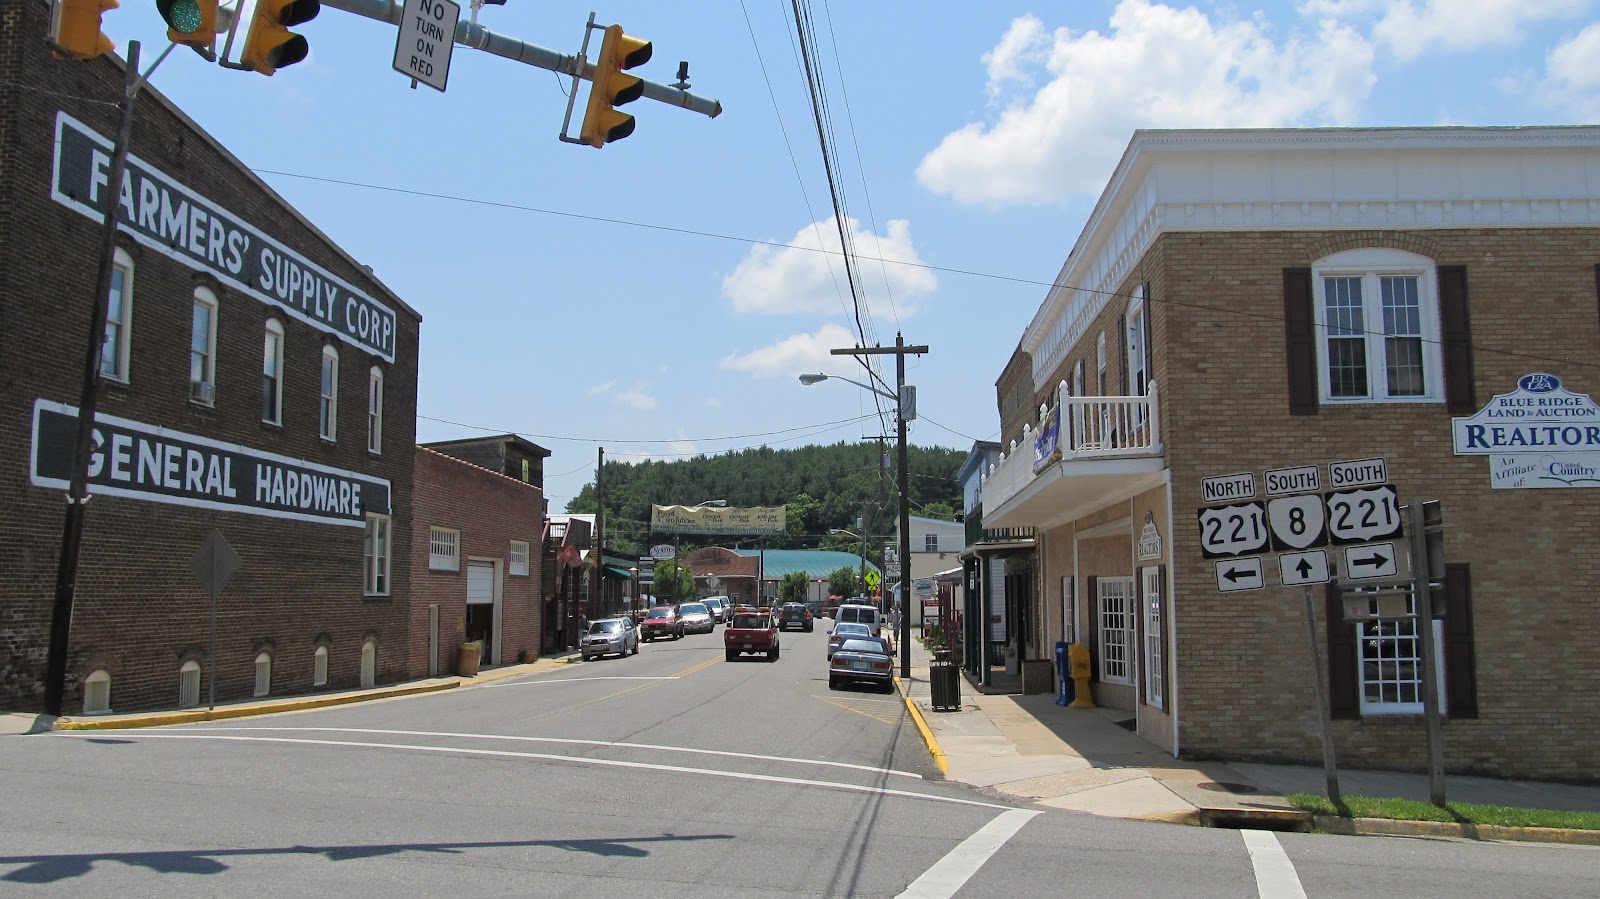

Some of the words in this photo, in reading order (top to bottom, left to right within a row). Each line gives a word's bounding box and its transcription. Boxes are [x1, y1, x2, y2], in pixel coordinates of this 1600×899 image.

[420, 0, 444, 20] NO
[416, 16, 443, 42] TURN
[416, 38, 434, 58] ON
[410, 55, 433, 77] RED
[89, 148, 250, 275] FARMERS'
[259, 247, 338, 322] SUPPLY
[1500, 398, 1534, 407] BLUE
[1538, 397, 1583, 406] RIDGE
[1487, 408, 1525, 418] LAND
[1535, 407, 1596, 417] AUCTION
[1465, 424, 1600, 449] REALTOR
[86, 428, 238, 499] GENERAL
[255, 462, 361, 517] HARDWARE
[1493, 464, 1536, 481] Affiliate
[1500, 458, 1514, 467] An
[1549, 462, 1596, 478] Country
[1269, 472, 1317, 492] SOUTH
[1333, 464, 1383, 484] SOUTH
[1205, 479, 1252, 498] NORTH
[1289, 507, 1306, 536] 8
[1334, 496, 1393, 531] 221
[1206, 512, 1260, 546] 221
